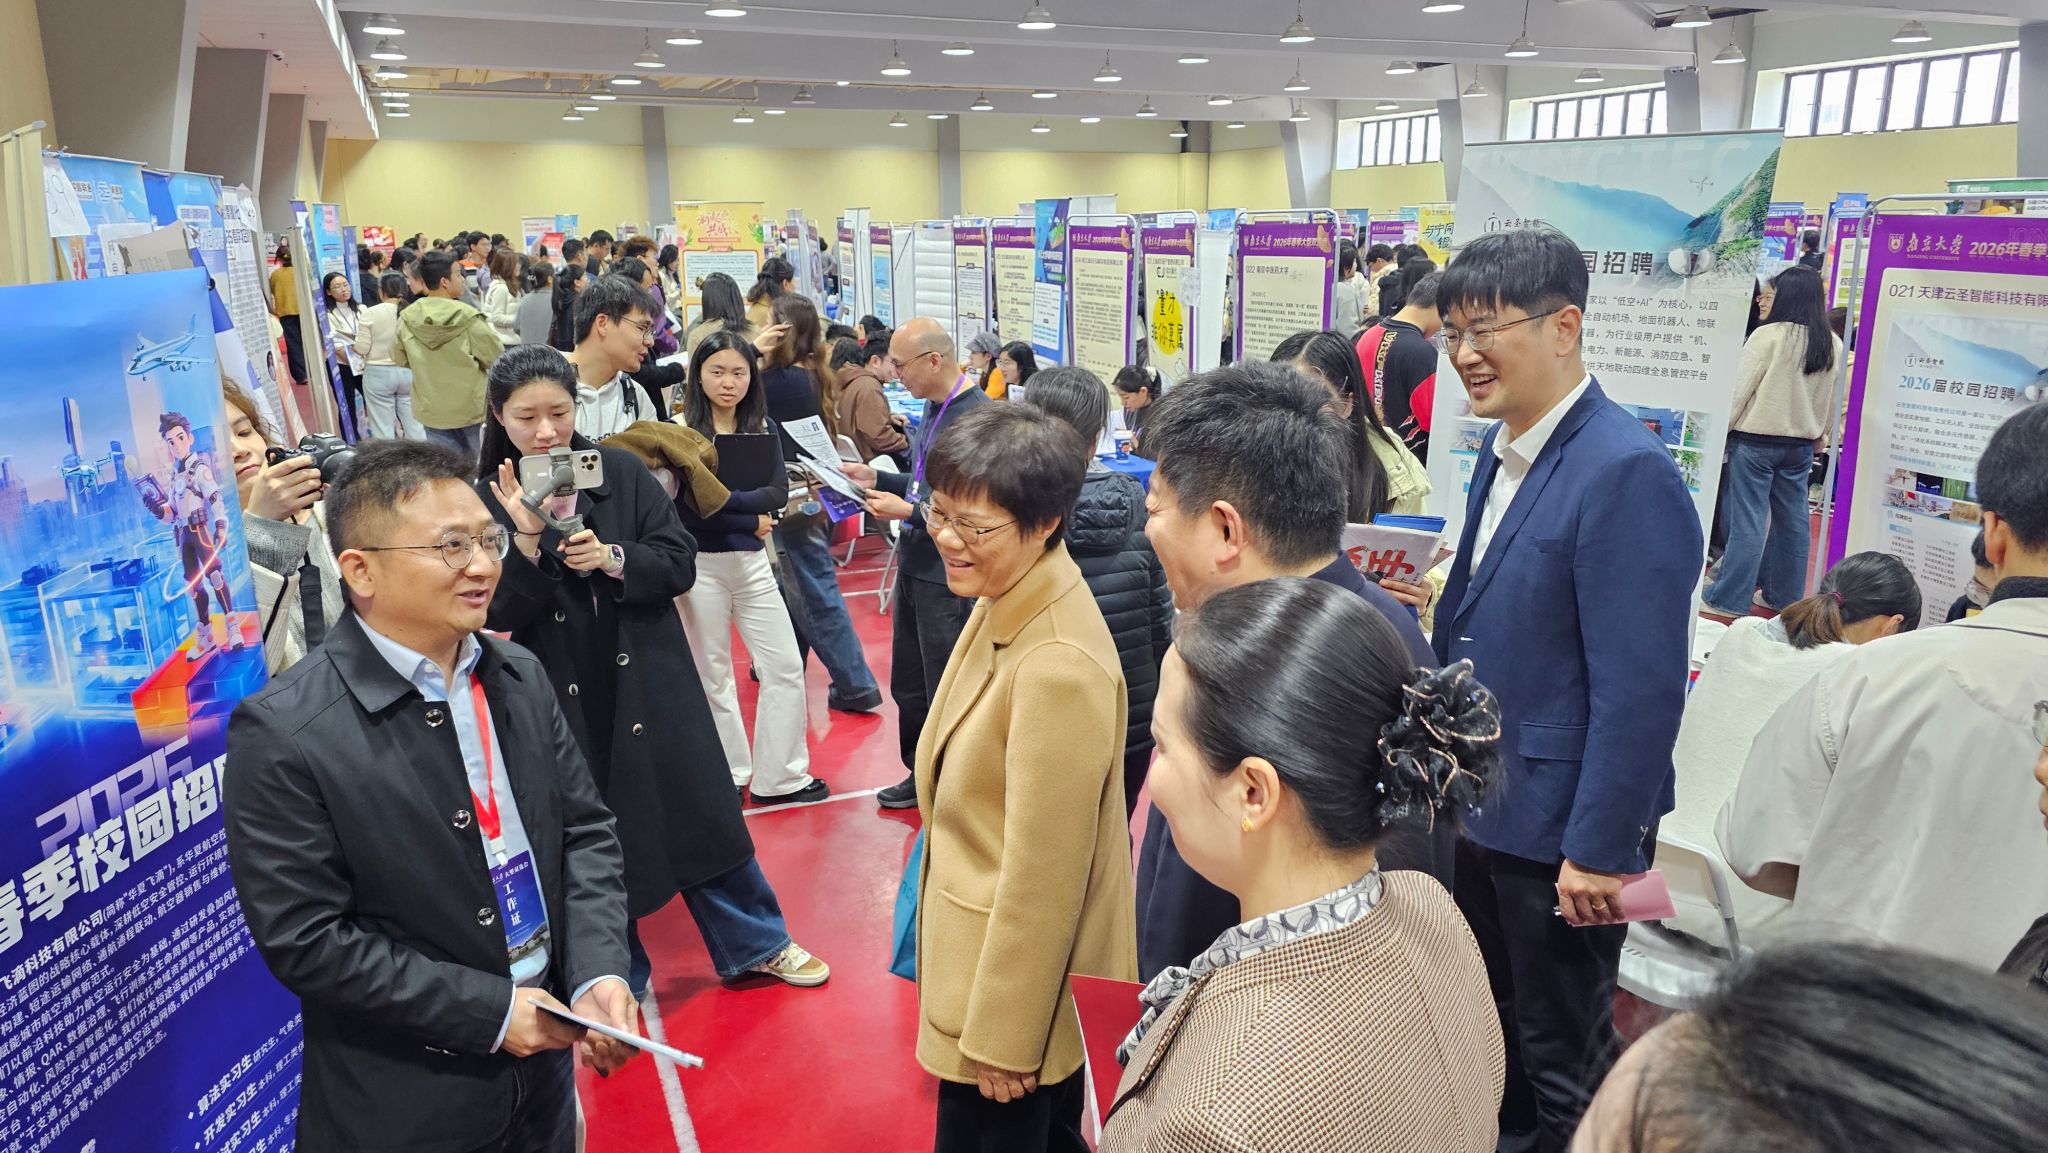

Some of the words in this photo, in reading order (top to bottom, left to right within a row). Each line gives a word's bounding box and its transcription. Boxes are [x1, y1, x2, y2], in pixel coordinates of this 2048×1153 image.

[1889, 284, 1914, 298] 021
[503, 880, 522, 927] 工作证
[197, 1053, 253, 1117] 算法实习生
[203, 1082, 258, 1146] 开发实习生
